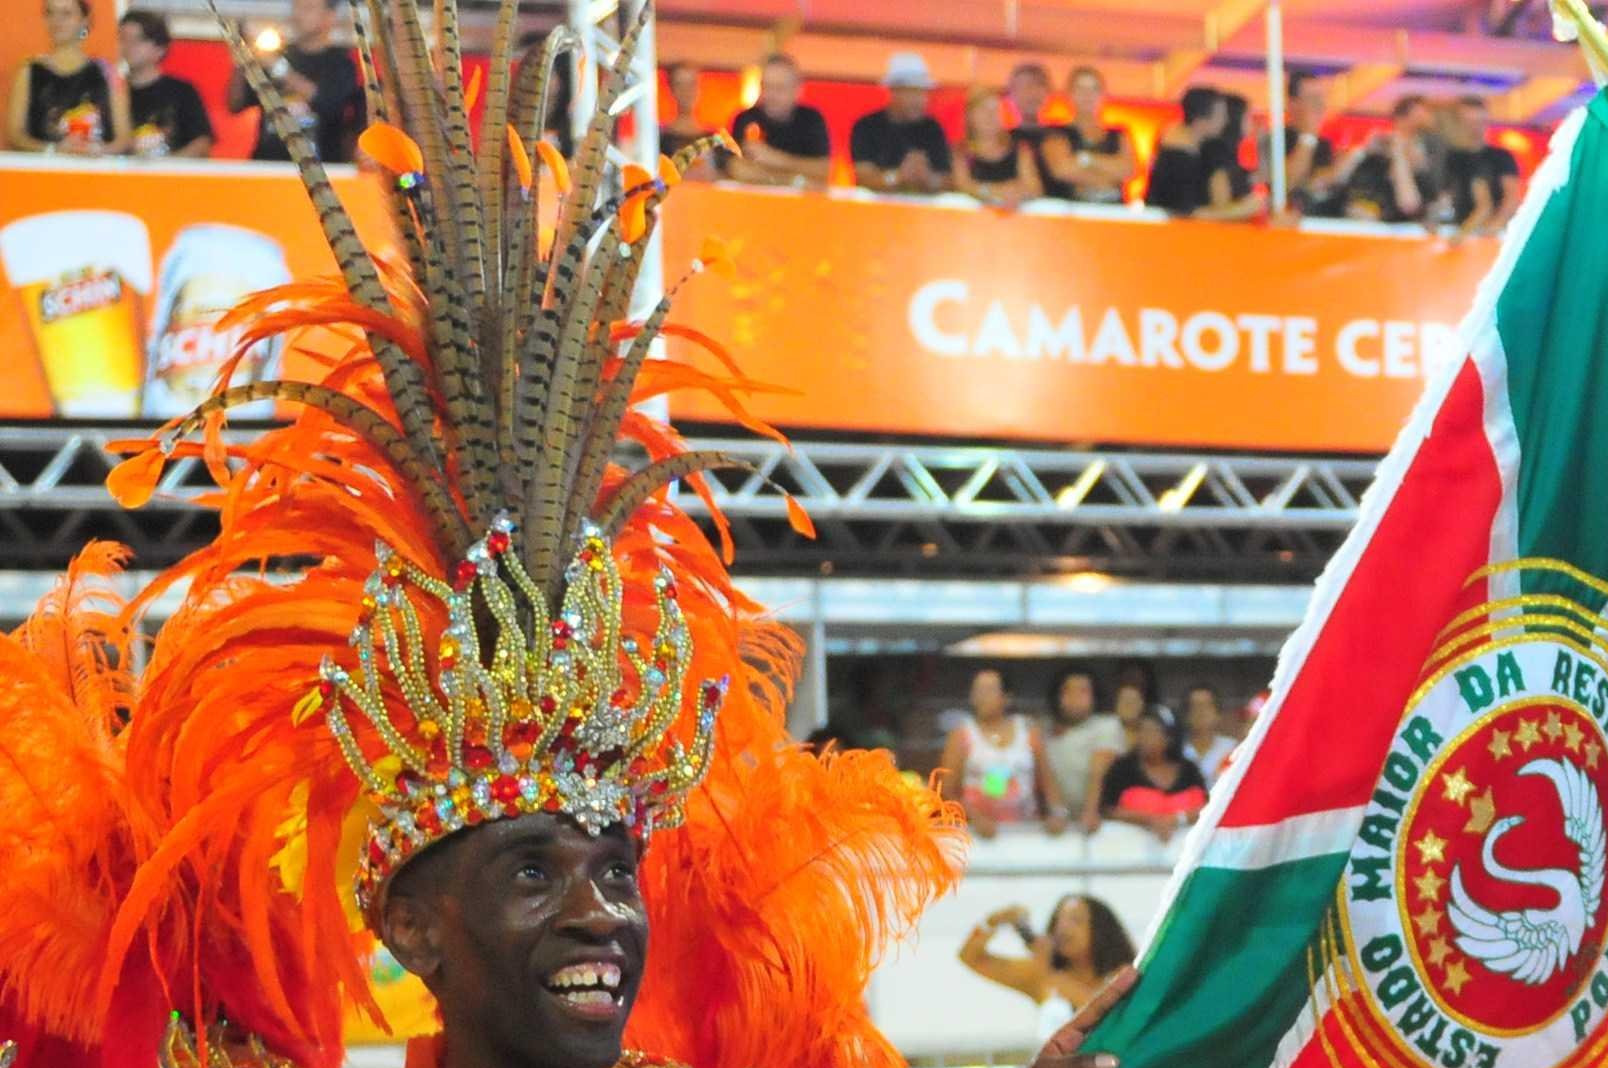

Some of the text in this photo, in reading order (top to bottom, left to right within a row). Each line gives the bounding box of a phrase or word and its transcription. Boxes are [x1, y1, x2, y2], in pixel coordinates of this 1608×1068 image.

[909, 280, 1319, 375] CAMAROTE
[1351, 715, 1444, 901] MAIOR
[1454, 650, 1527, 714] DA
